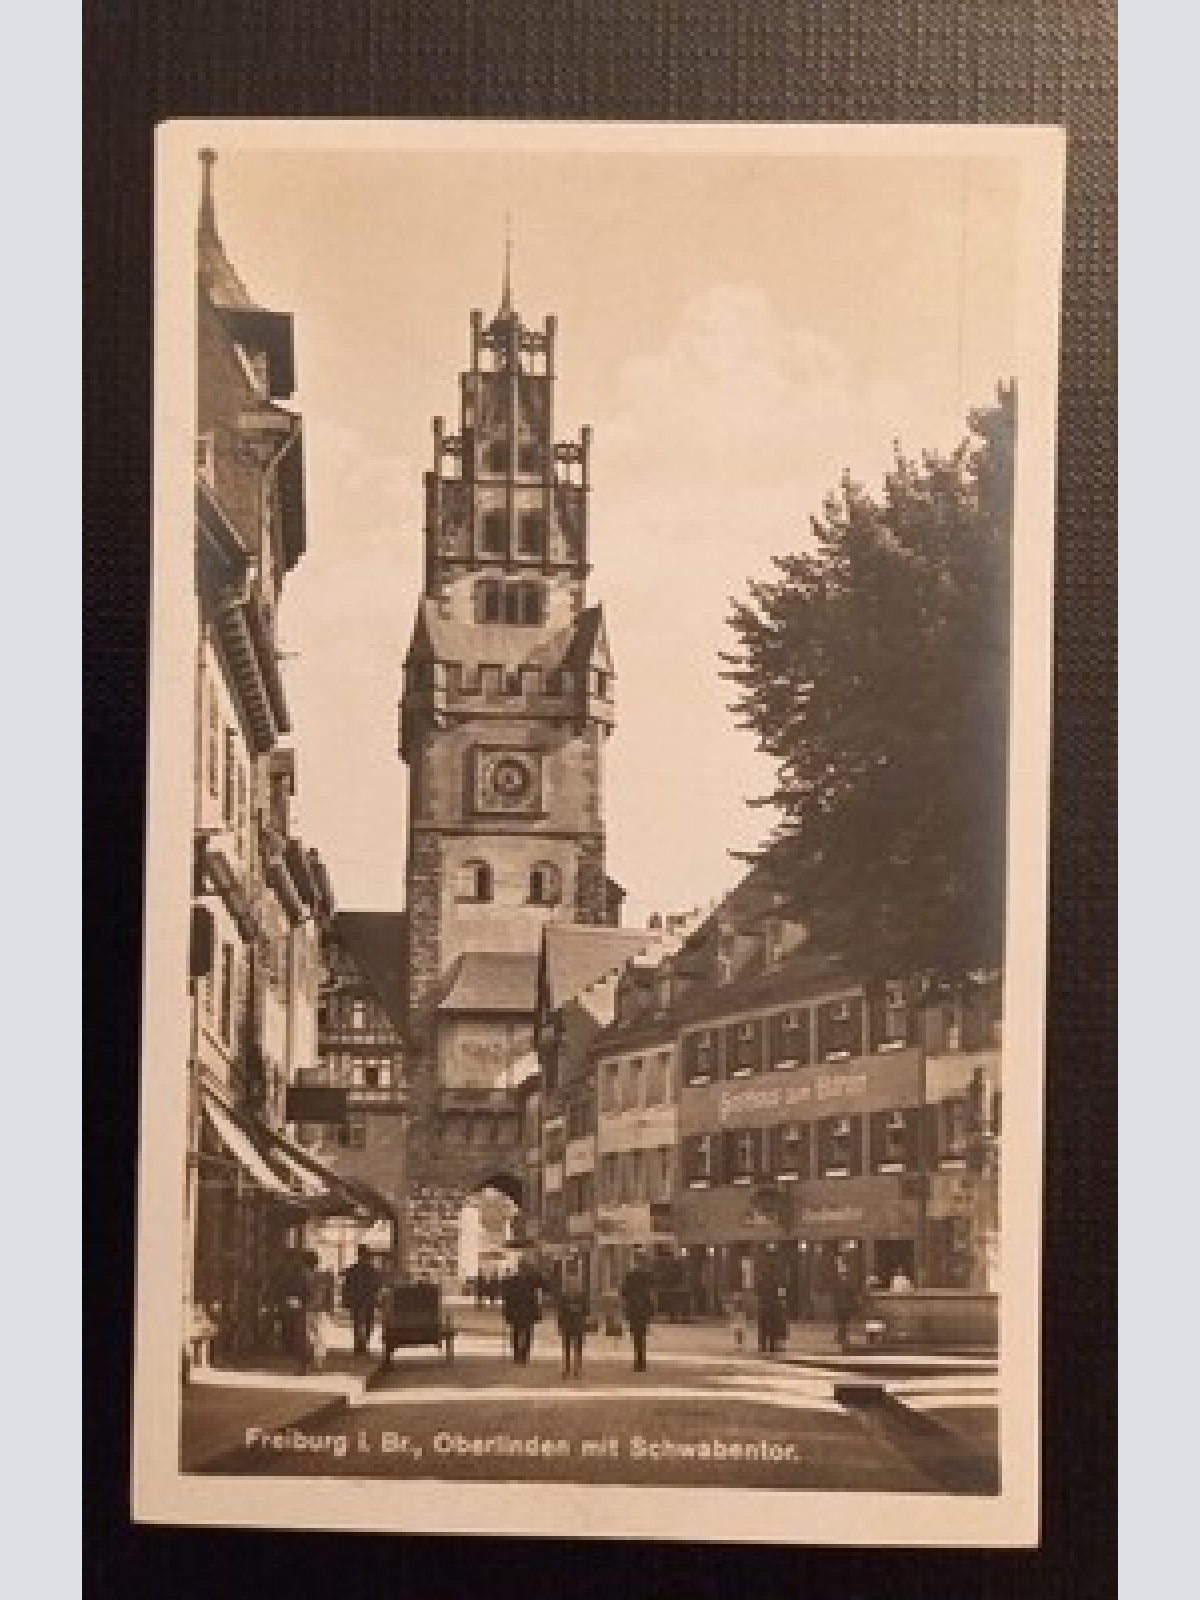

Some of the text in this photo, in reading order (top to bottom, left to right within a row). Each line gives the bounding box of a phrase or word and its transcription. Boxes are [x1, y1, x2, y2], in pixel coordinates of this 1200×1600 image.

[245, 1427, 347, 1457] Freiburg
[433, 1431, 571, 1458] Oberlinden
[581, 1434, 619, 1459] mit
[629, 1435, 803, 1463] Schwabentor.
